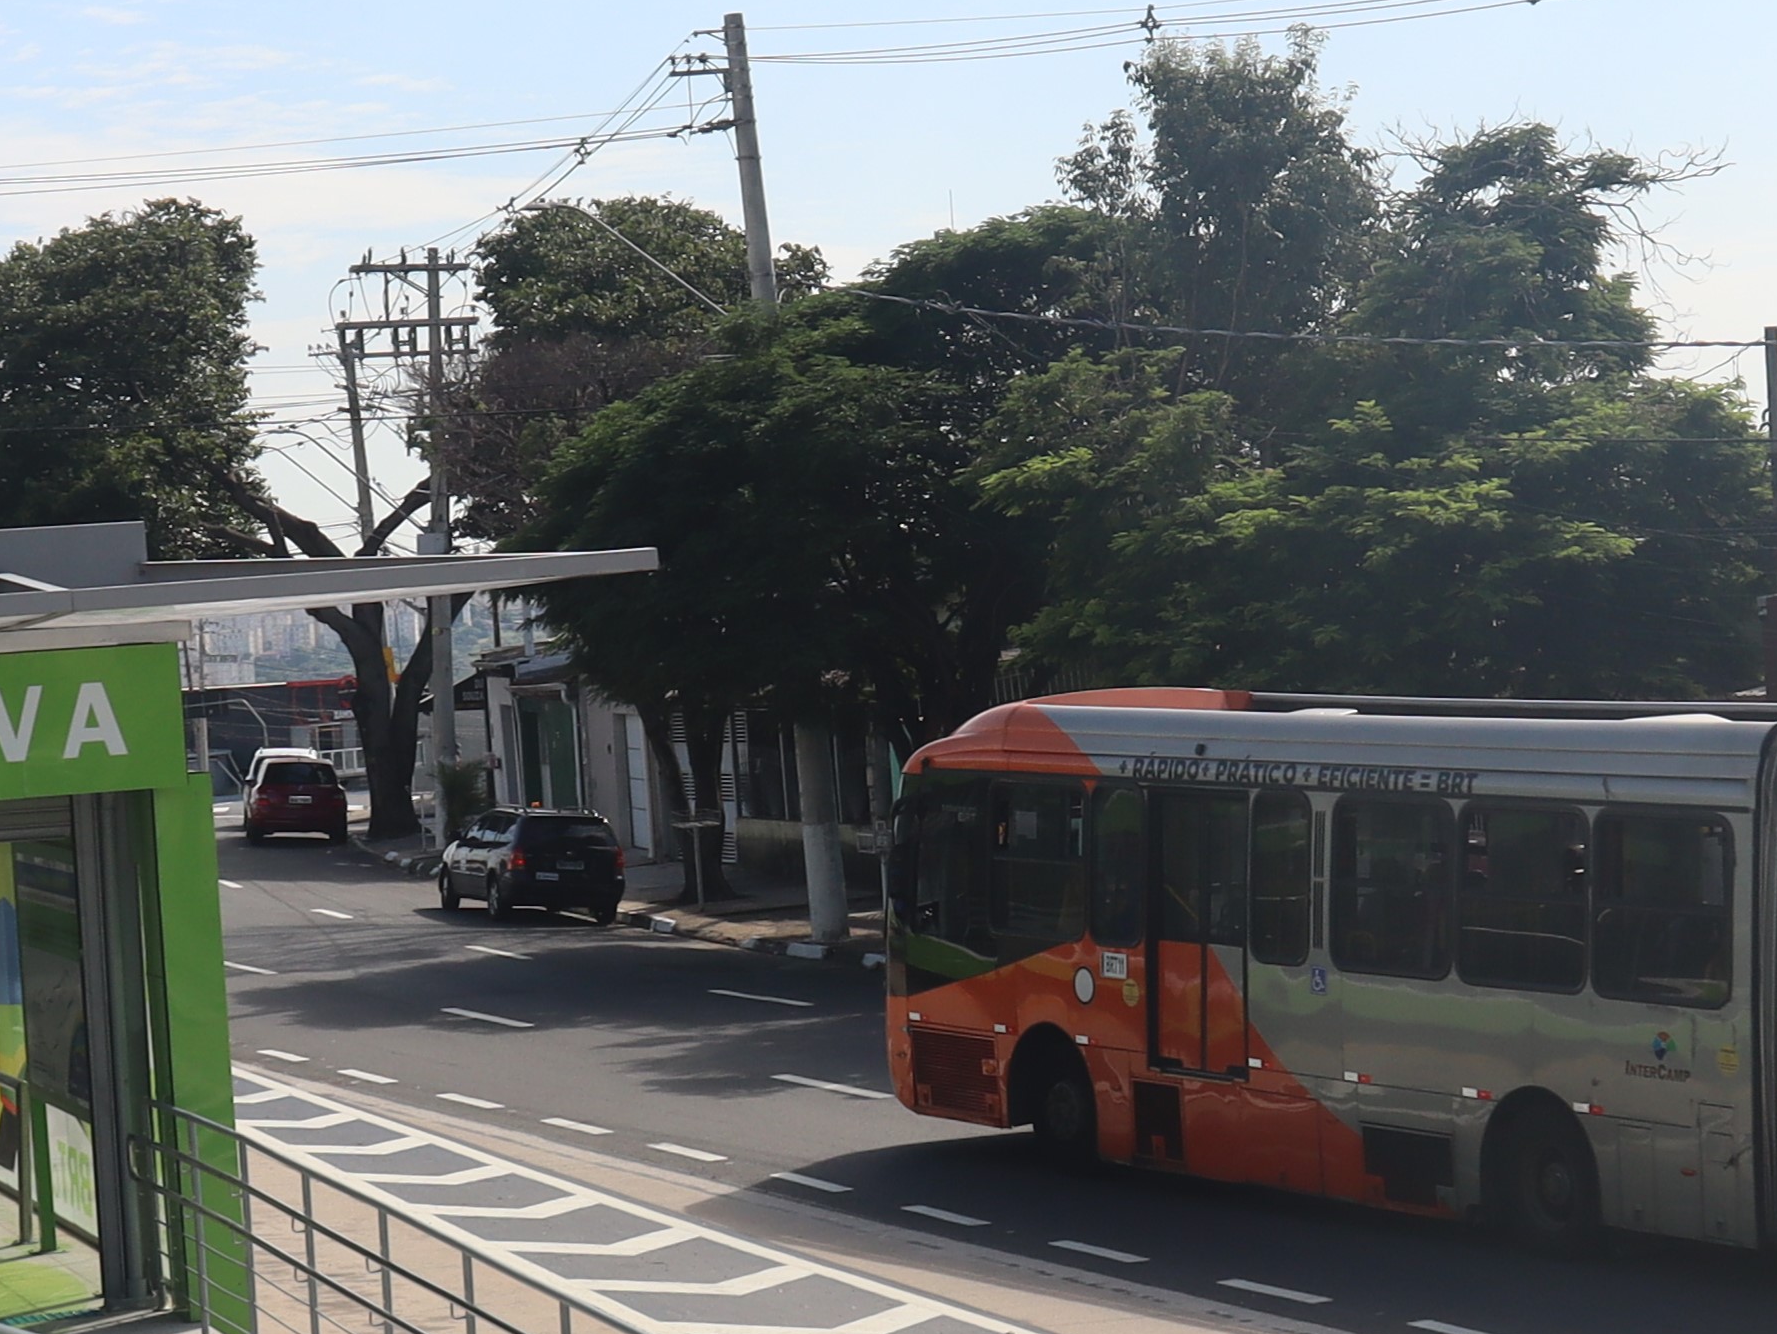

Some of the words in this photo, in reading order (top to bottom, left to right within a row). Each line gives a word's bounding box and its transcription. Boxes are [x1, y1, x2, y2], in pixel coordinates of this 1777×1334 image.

[1132, 750, 1200, 781] RÁPIDO
[1215, 754, 1297, 785] PRÁTICO
[1318, 764, 1417, 792] EFICIENTE
[1436, 770, 1479, 795] BRT
